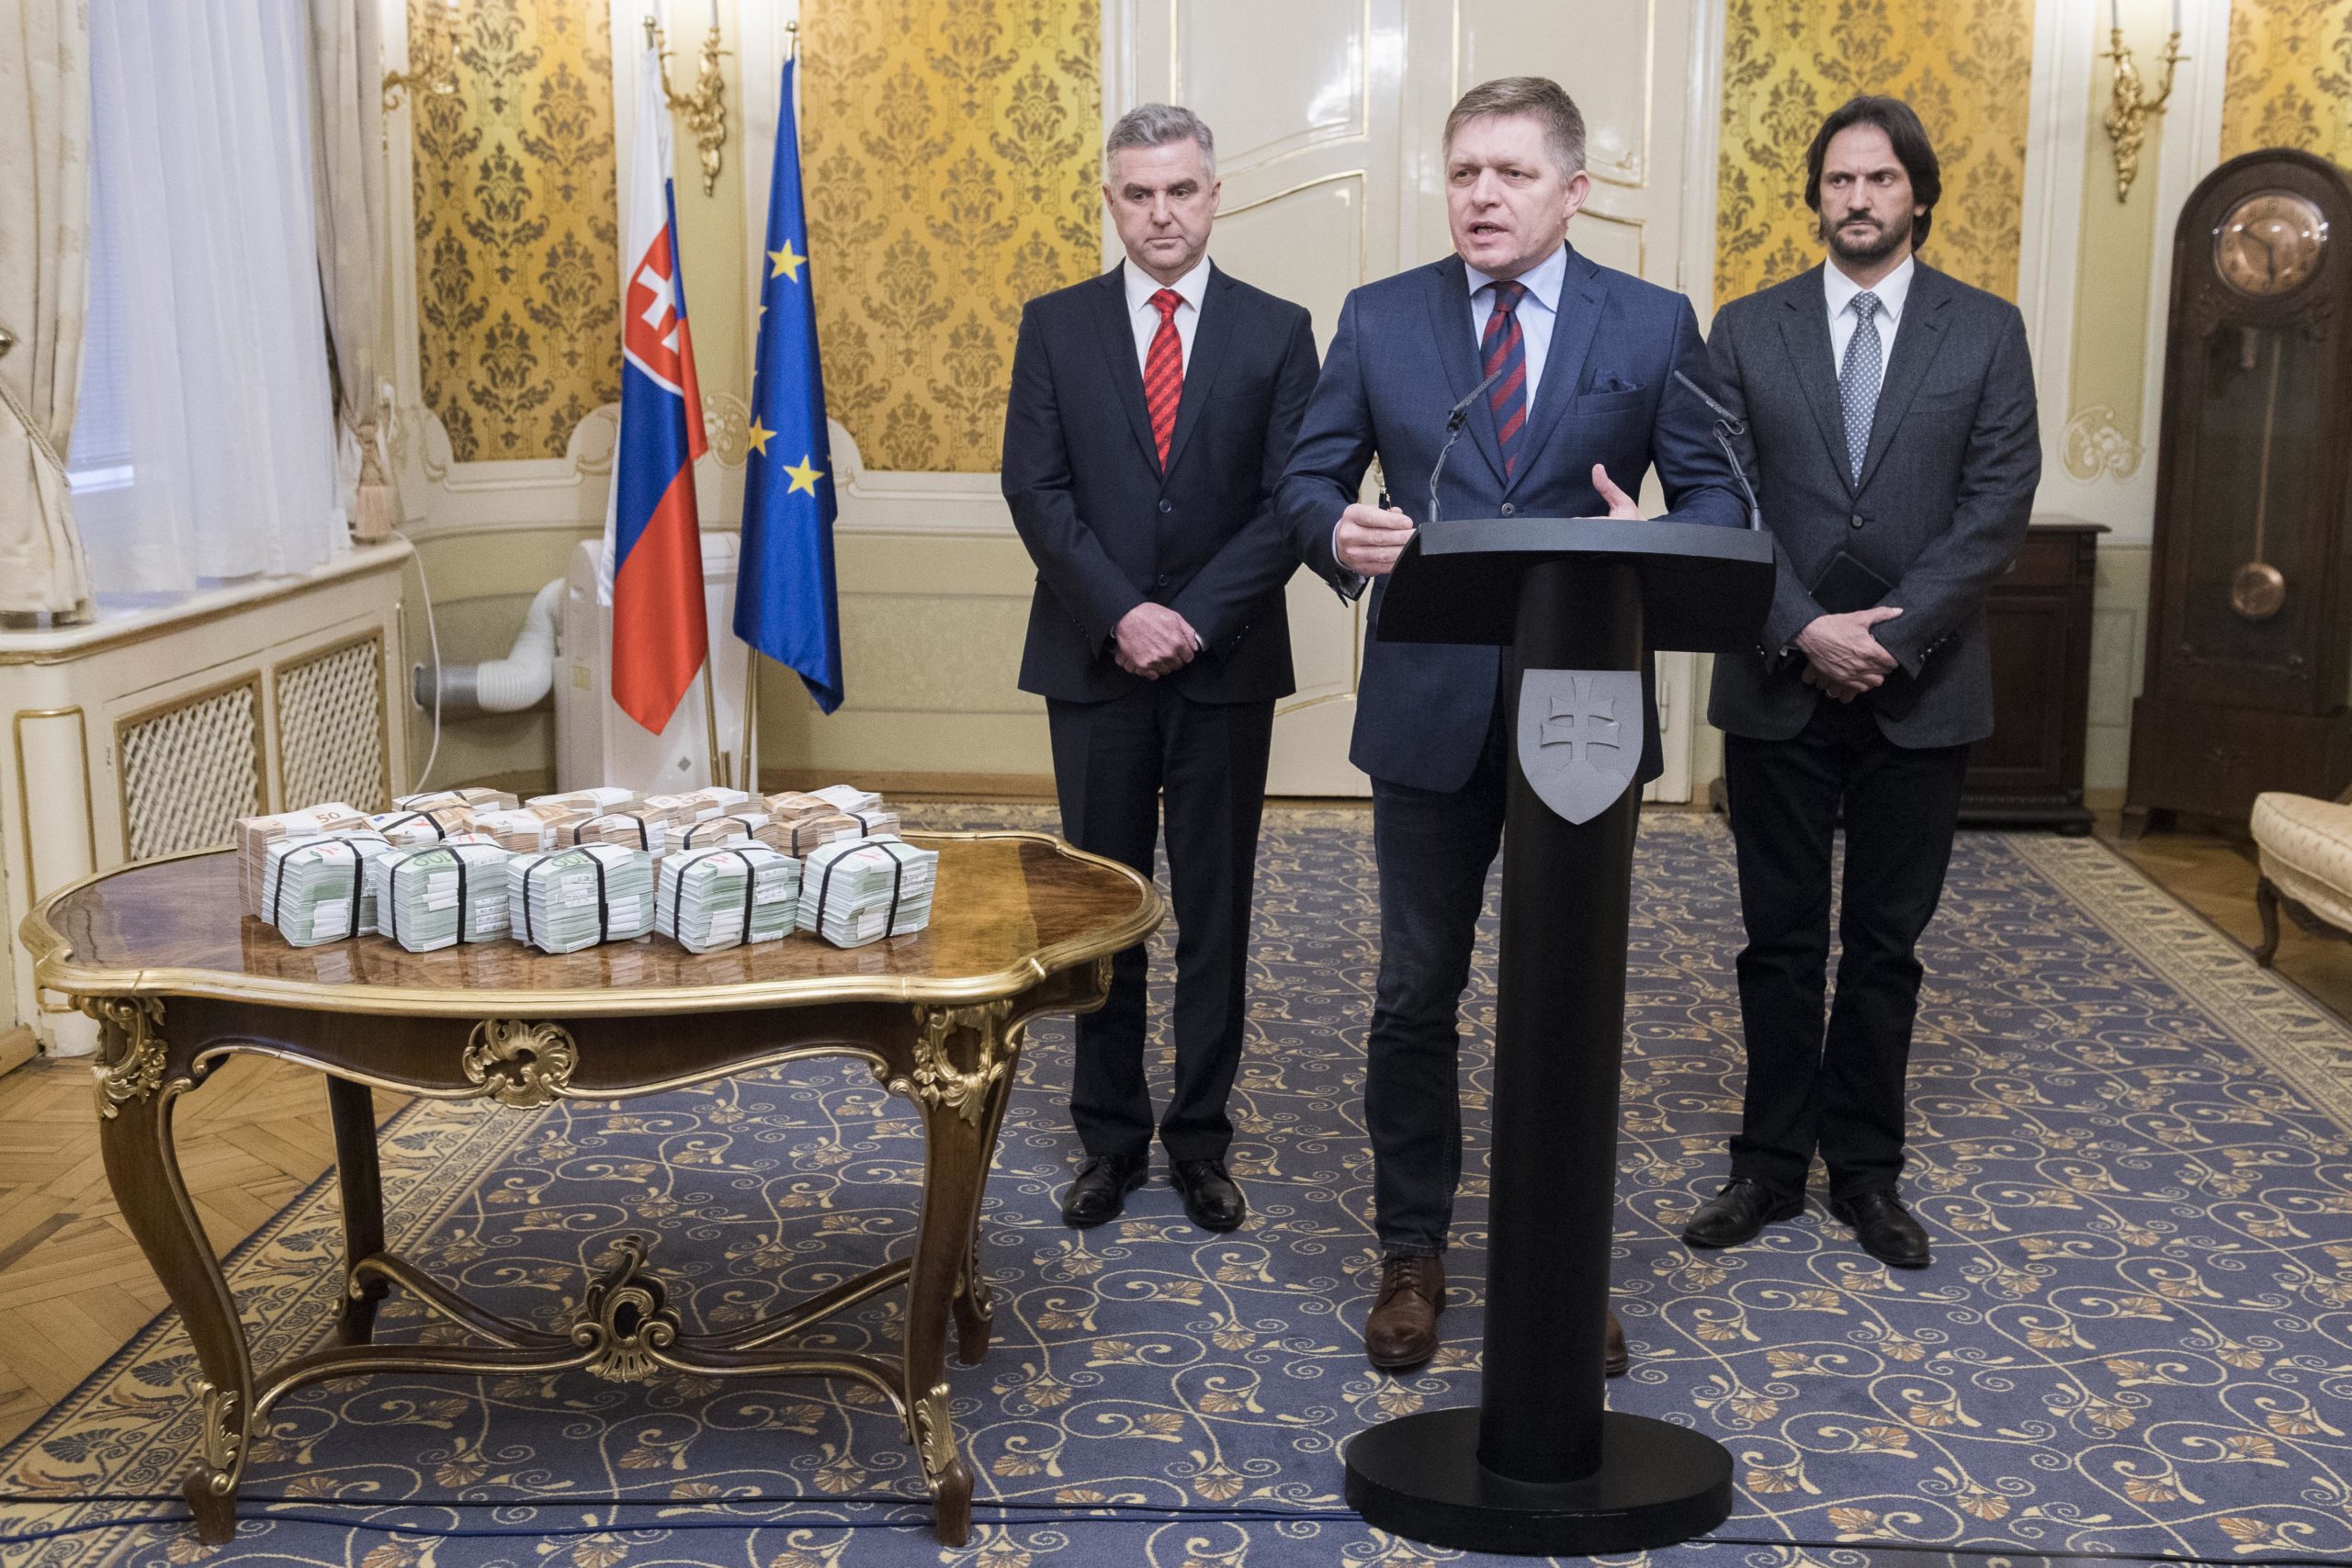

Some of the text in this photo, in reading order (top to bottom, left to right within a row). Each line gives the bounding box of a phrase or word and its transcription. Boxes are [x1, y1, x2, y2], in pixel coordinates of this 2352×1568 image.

[316, 812, 341, 823] 50
[413, 852, 452, 867] 100
[551, 853, 589, 867] 100
